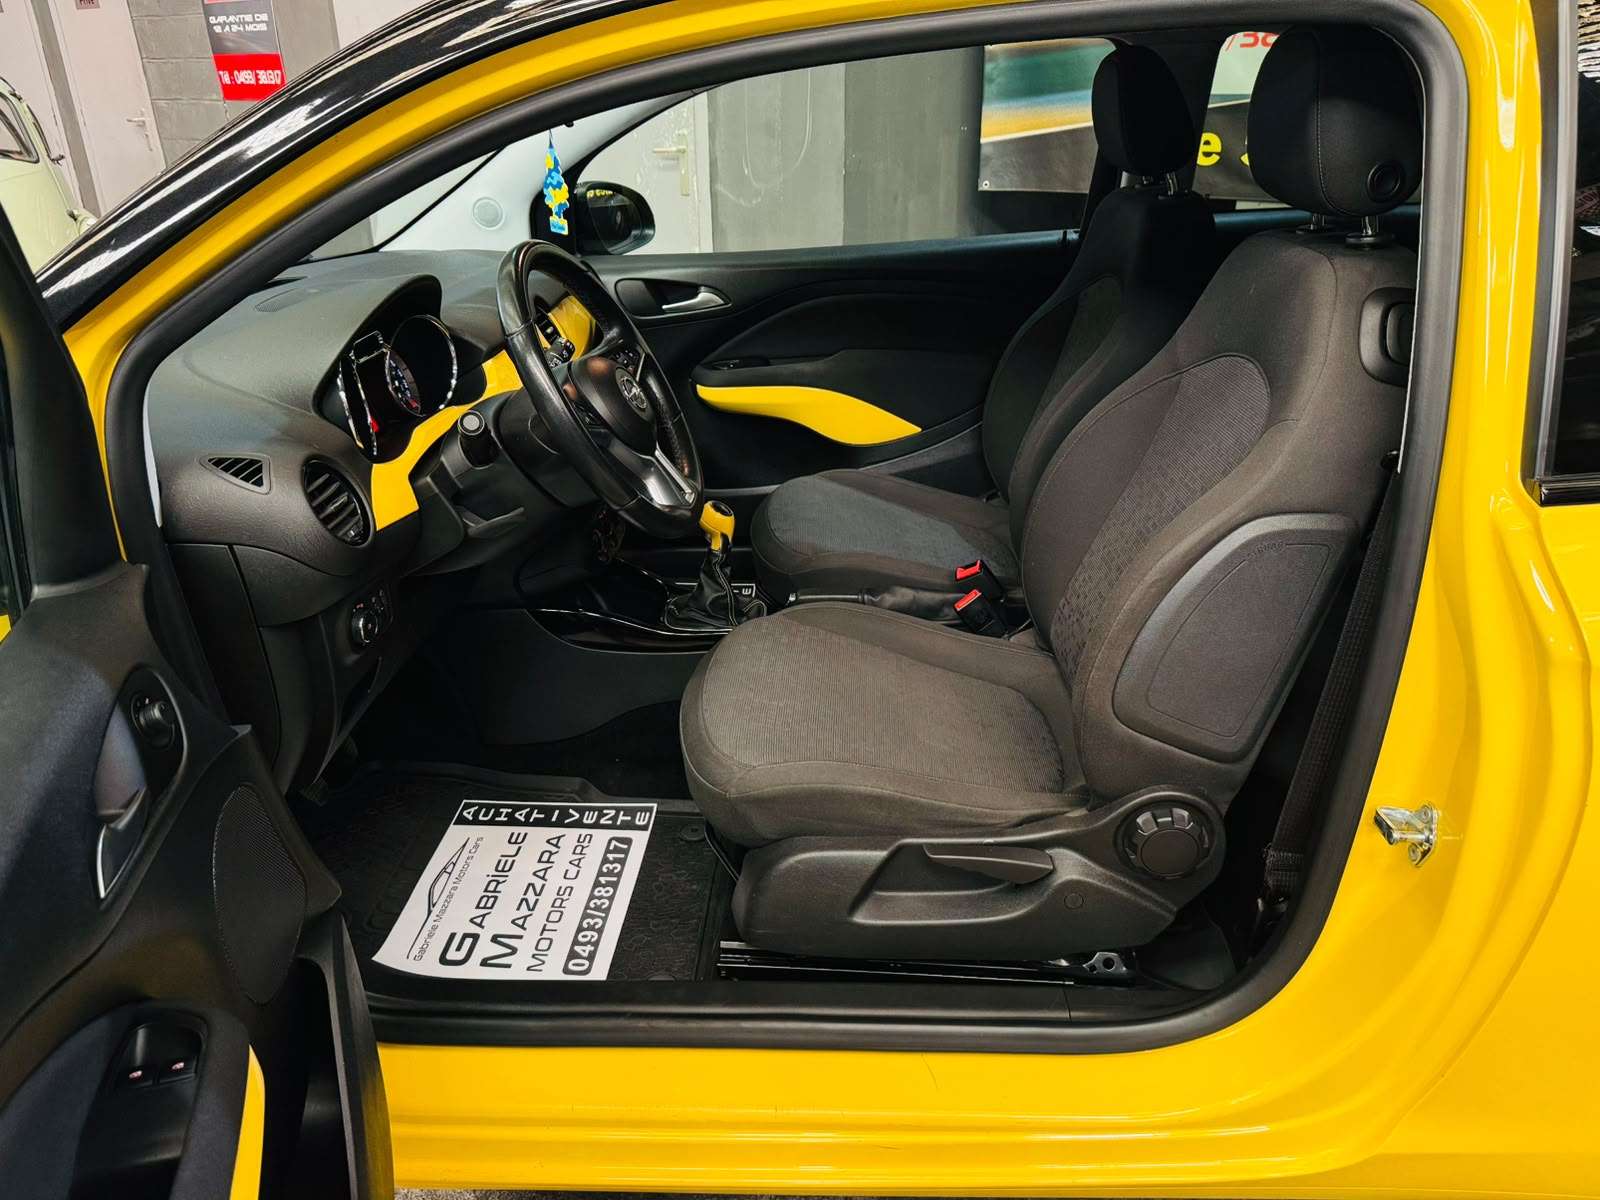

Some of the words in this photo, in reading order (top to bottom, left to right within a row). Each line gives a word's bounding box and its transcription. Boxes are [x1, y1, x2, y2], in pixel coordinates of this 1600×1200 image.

[209, 15, 253, 24] GARANTIE
[254, 13, 268, 22] DE
[231, 24, 244, 32] 24
[245, 23, 267, 32] MOIS
[413, 922, 439, 961] Gabriele
[436, 885, 459, 922] Mazzara
[453, 854, 474, 887] Motors
[471, 836, 484, 855] Cars
[479, 834, 566, 968] MAZZARA
[526, 886, 574, 972] MOTORS
[563, 833, 593, 880] CARS
[568, 839, 628, 971] 0493/381317
